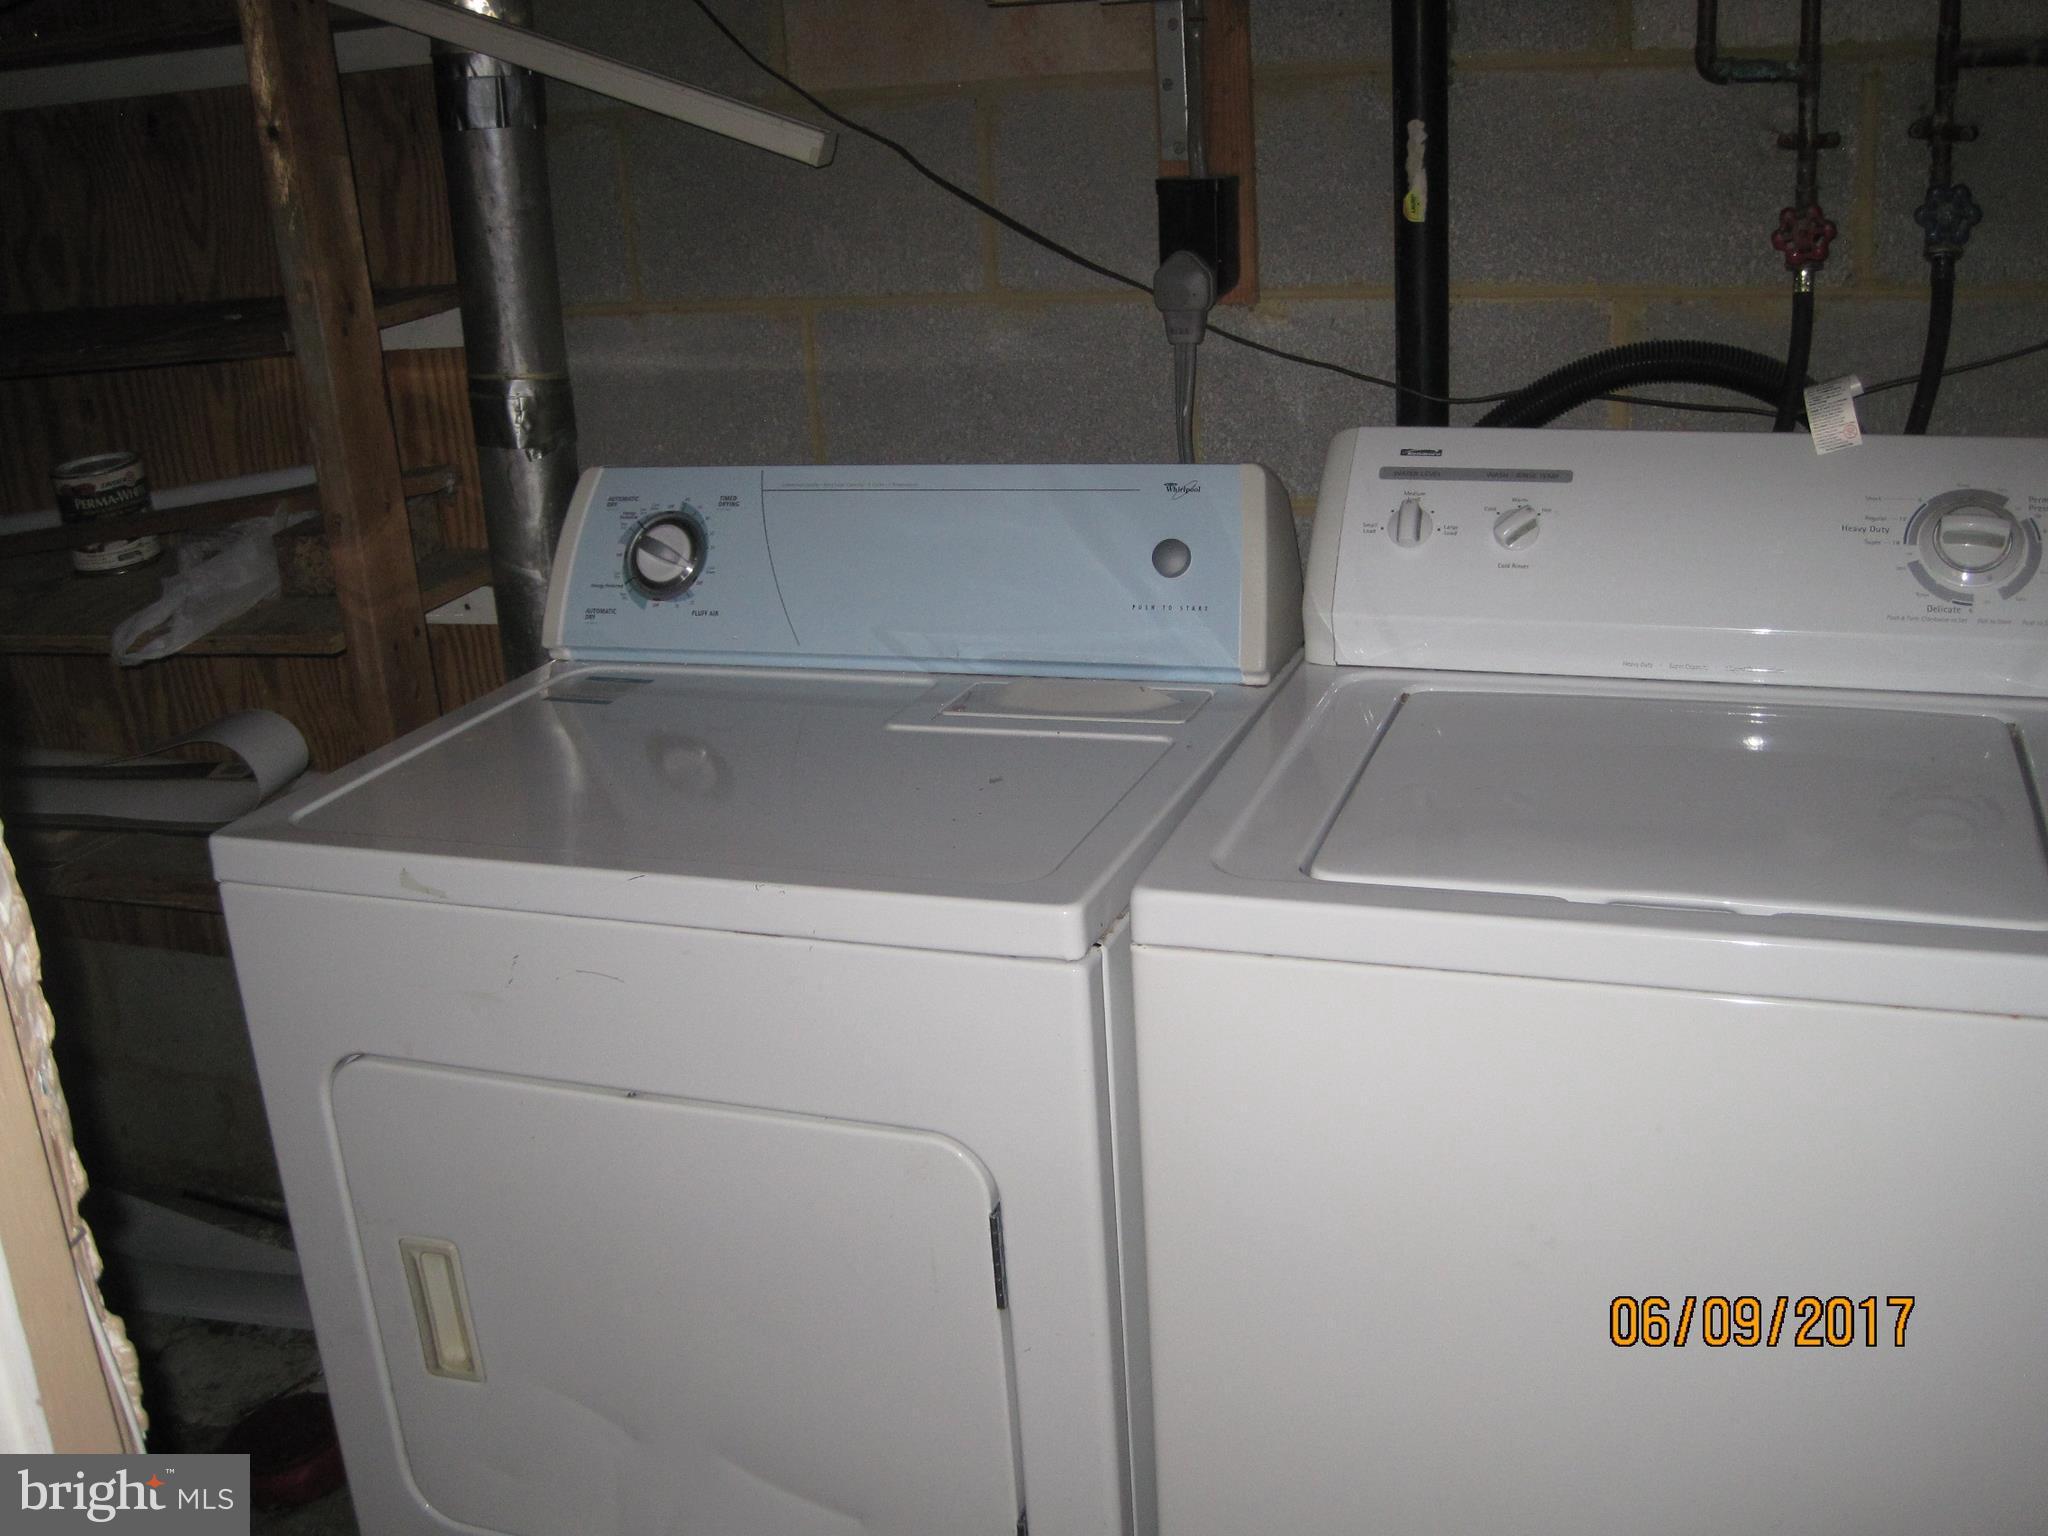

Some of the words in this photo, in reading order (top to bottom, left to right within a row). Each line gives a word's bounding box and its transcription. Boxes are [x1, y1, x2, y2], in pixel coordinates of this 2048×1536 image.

[1163, 481, 1202, 495] Whirlpool
[1841, 525, 1868, 534] Heavy
[1869, 525, 1890, 534] Duty
[1926, 604, 1962, 614] Delicate
